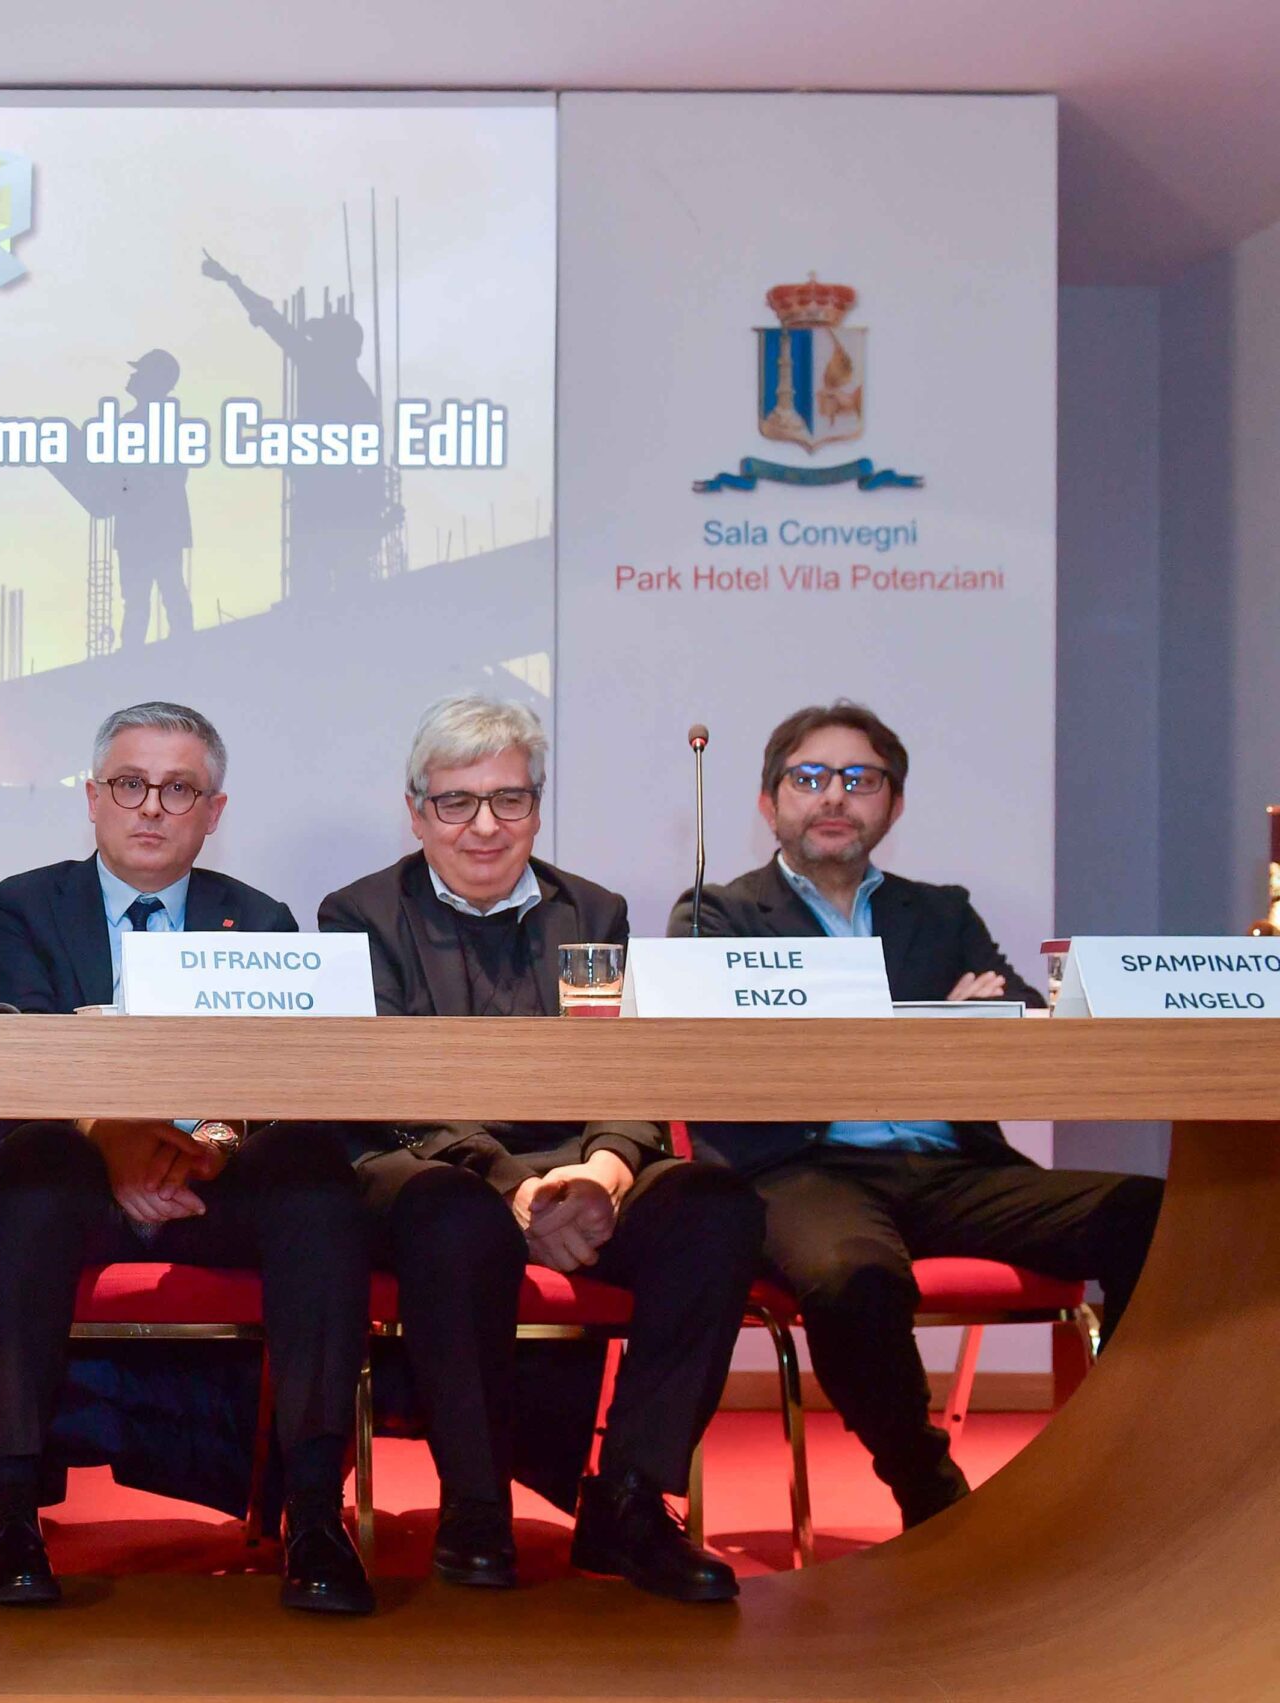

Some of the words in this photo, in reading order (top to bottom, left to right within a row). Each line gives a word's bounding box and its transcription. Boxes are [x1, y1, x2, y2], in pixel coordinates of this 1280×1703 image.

[85, 400, 207, 465] delle
[223, 401, 380, 467] Casse
[397, 402, 505, 467] Edili
[703, 519, 769, 547] Sala
[778, 519, 918, 553] Convegni
[615, 564, 682, 591] Park
[693, 565, 769, 591] Hotel
[779, 565, 841, 591] Villa
[851, 564, 1004, 591] Potenziani
[180, 950, 206, 970] DI
[213, 951, 322, 971] FRANCO
[725, 951, 804, 970] PELLE
[1121, 954, 1280, 972] SPAMPINATO
[194, 990, 315, 1011] ANTONIO
[734, 988, 808, 1007] ENZO
[1164, 992, 1265, 1009] ANGELO
